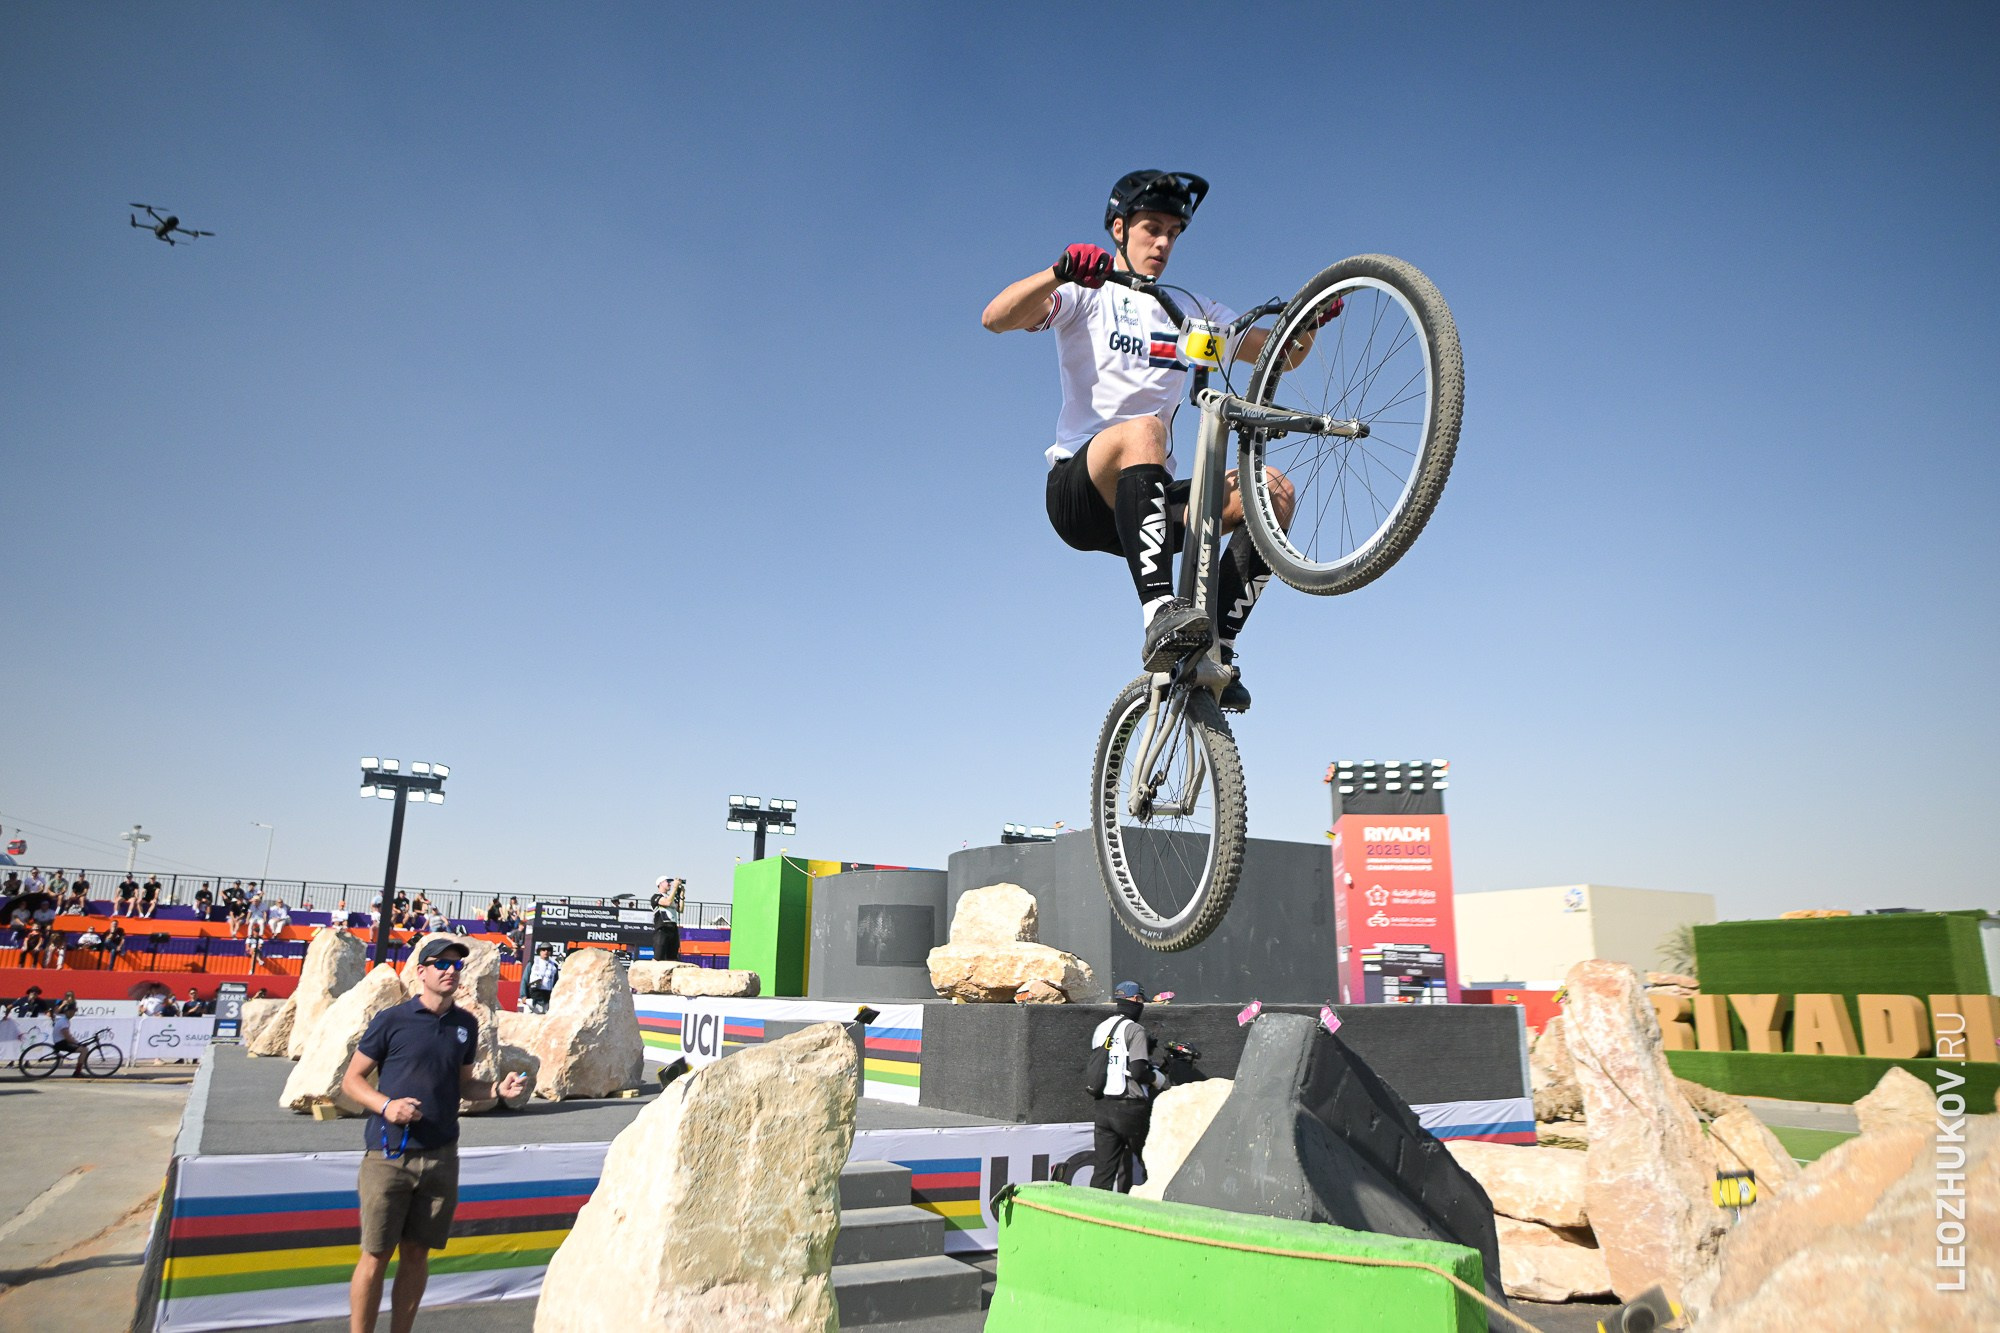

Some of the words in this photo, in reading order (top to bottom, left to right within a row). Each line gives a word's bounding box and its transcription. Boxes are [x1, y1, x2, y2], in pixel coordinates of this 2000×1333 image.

[1109, 330, 1143, 356] GBR
[1203, 338, 1217, 357] 5
[1363, 826, 1430, 842] RIYADH
[1366, 844, 1401, 856] 2025
[1405, 844, 1431, 856] UCI
[546, 907, 566, 916] UCI
[587, 931, 618, 941] FINISH
[225, 1001, 239, 1019] 3
[683, 1013, 719, 1057] UCI
